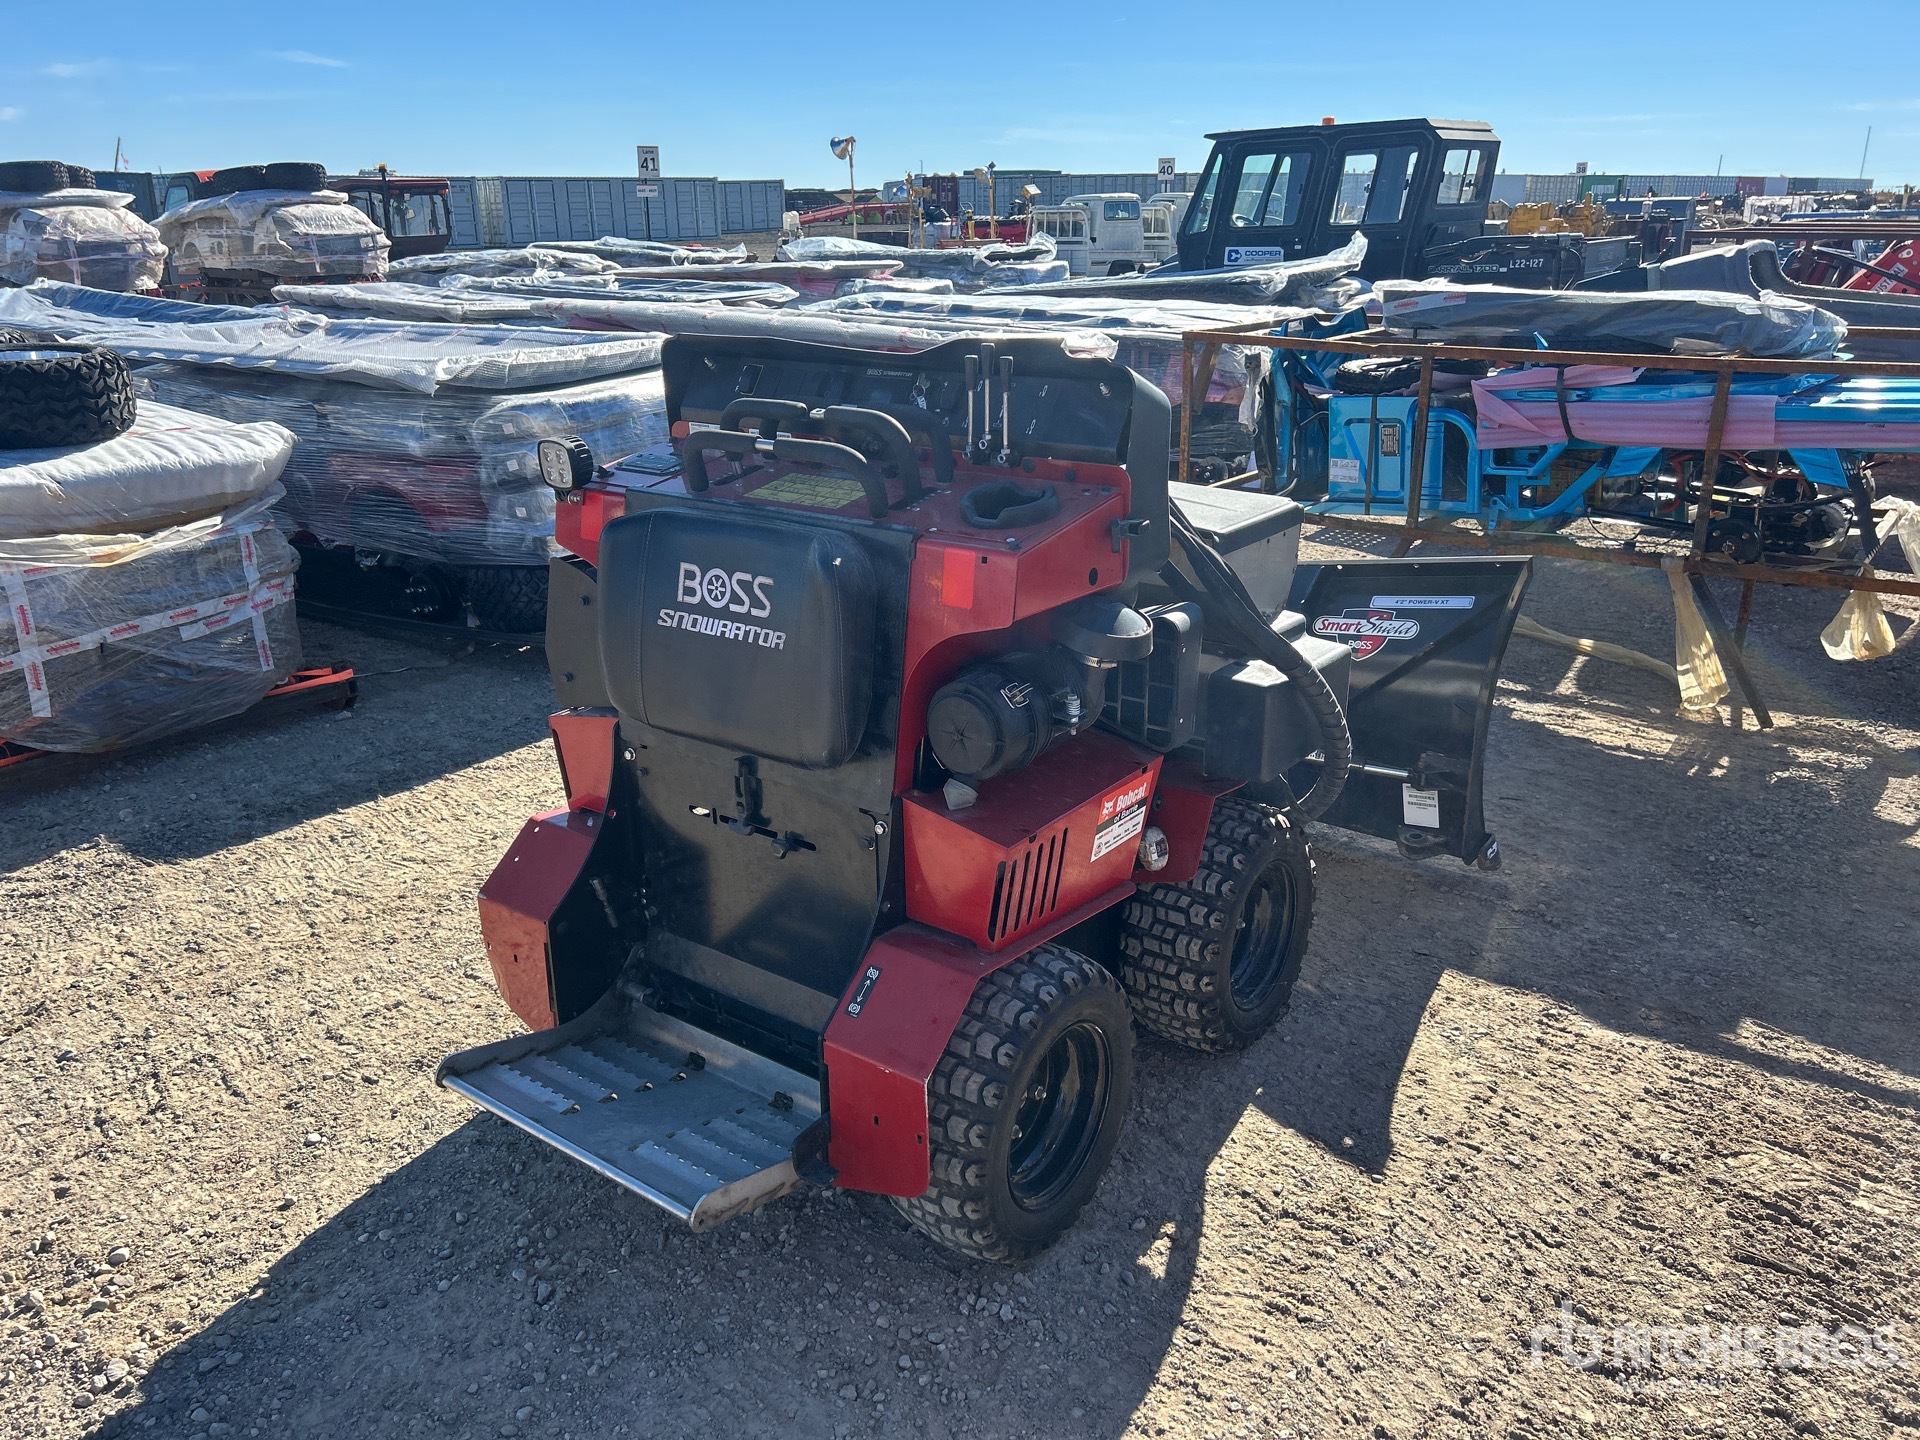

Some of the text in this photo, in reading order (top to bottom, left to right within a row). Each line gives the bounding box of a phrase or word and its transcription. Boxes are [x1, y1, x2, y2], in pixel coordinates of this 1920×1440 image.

[640, 157, 658, 171] 41
[1159, 165, 1174, 175] 40
[1473, 264, 1499, 273] 1700
[1509, 258, 1544, 268] L22-127
[866, 368, 883, 376] BOSS
[677, 561, 774, 618] BOSS
[657, 608, 786, 650] SNOWRATOR
[1348, 640, 1373, 649] BOSS
[1116, 782, 1147, 812] Bobcat
[1113, 812, 1122, 823] of
[1120, 804, 1139, 820] Barrie
